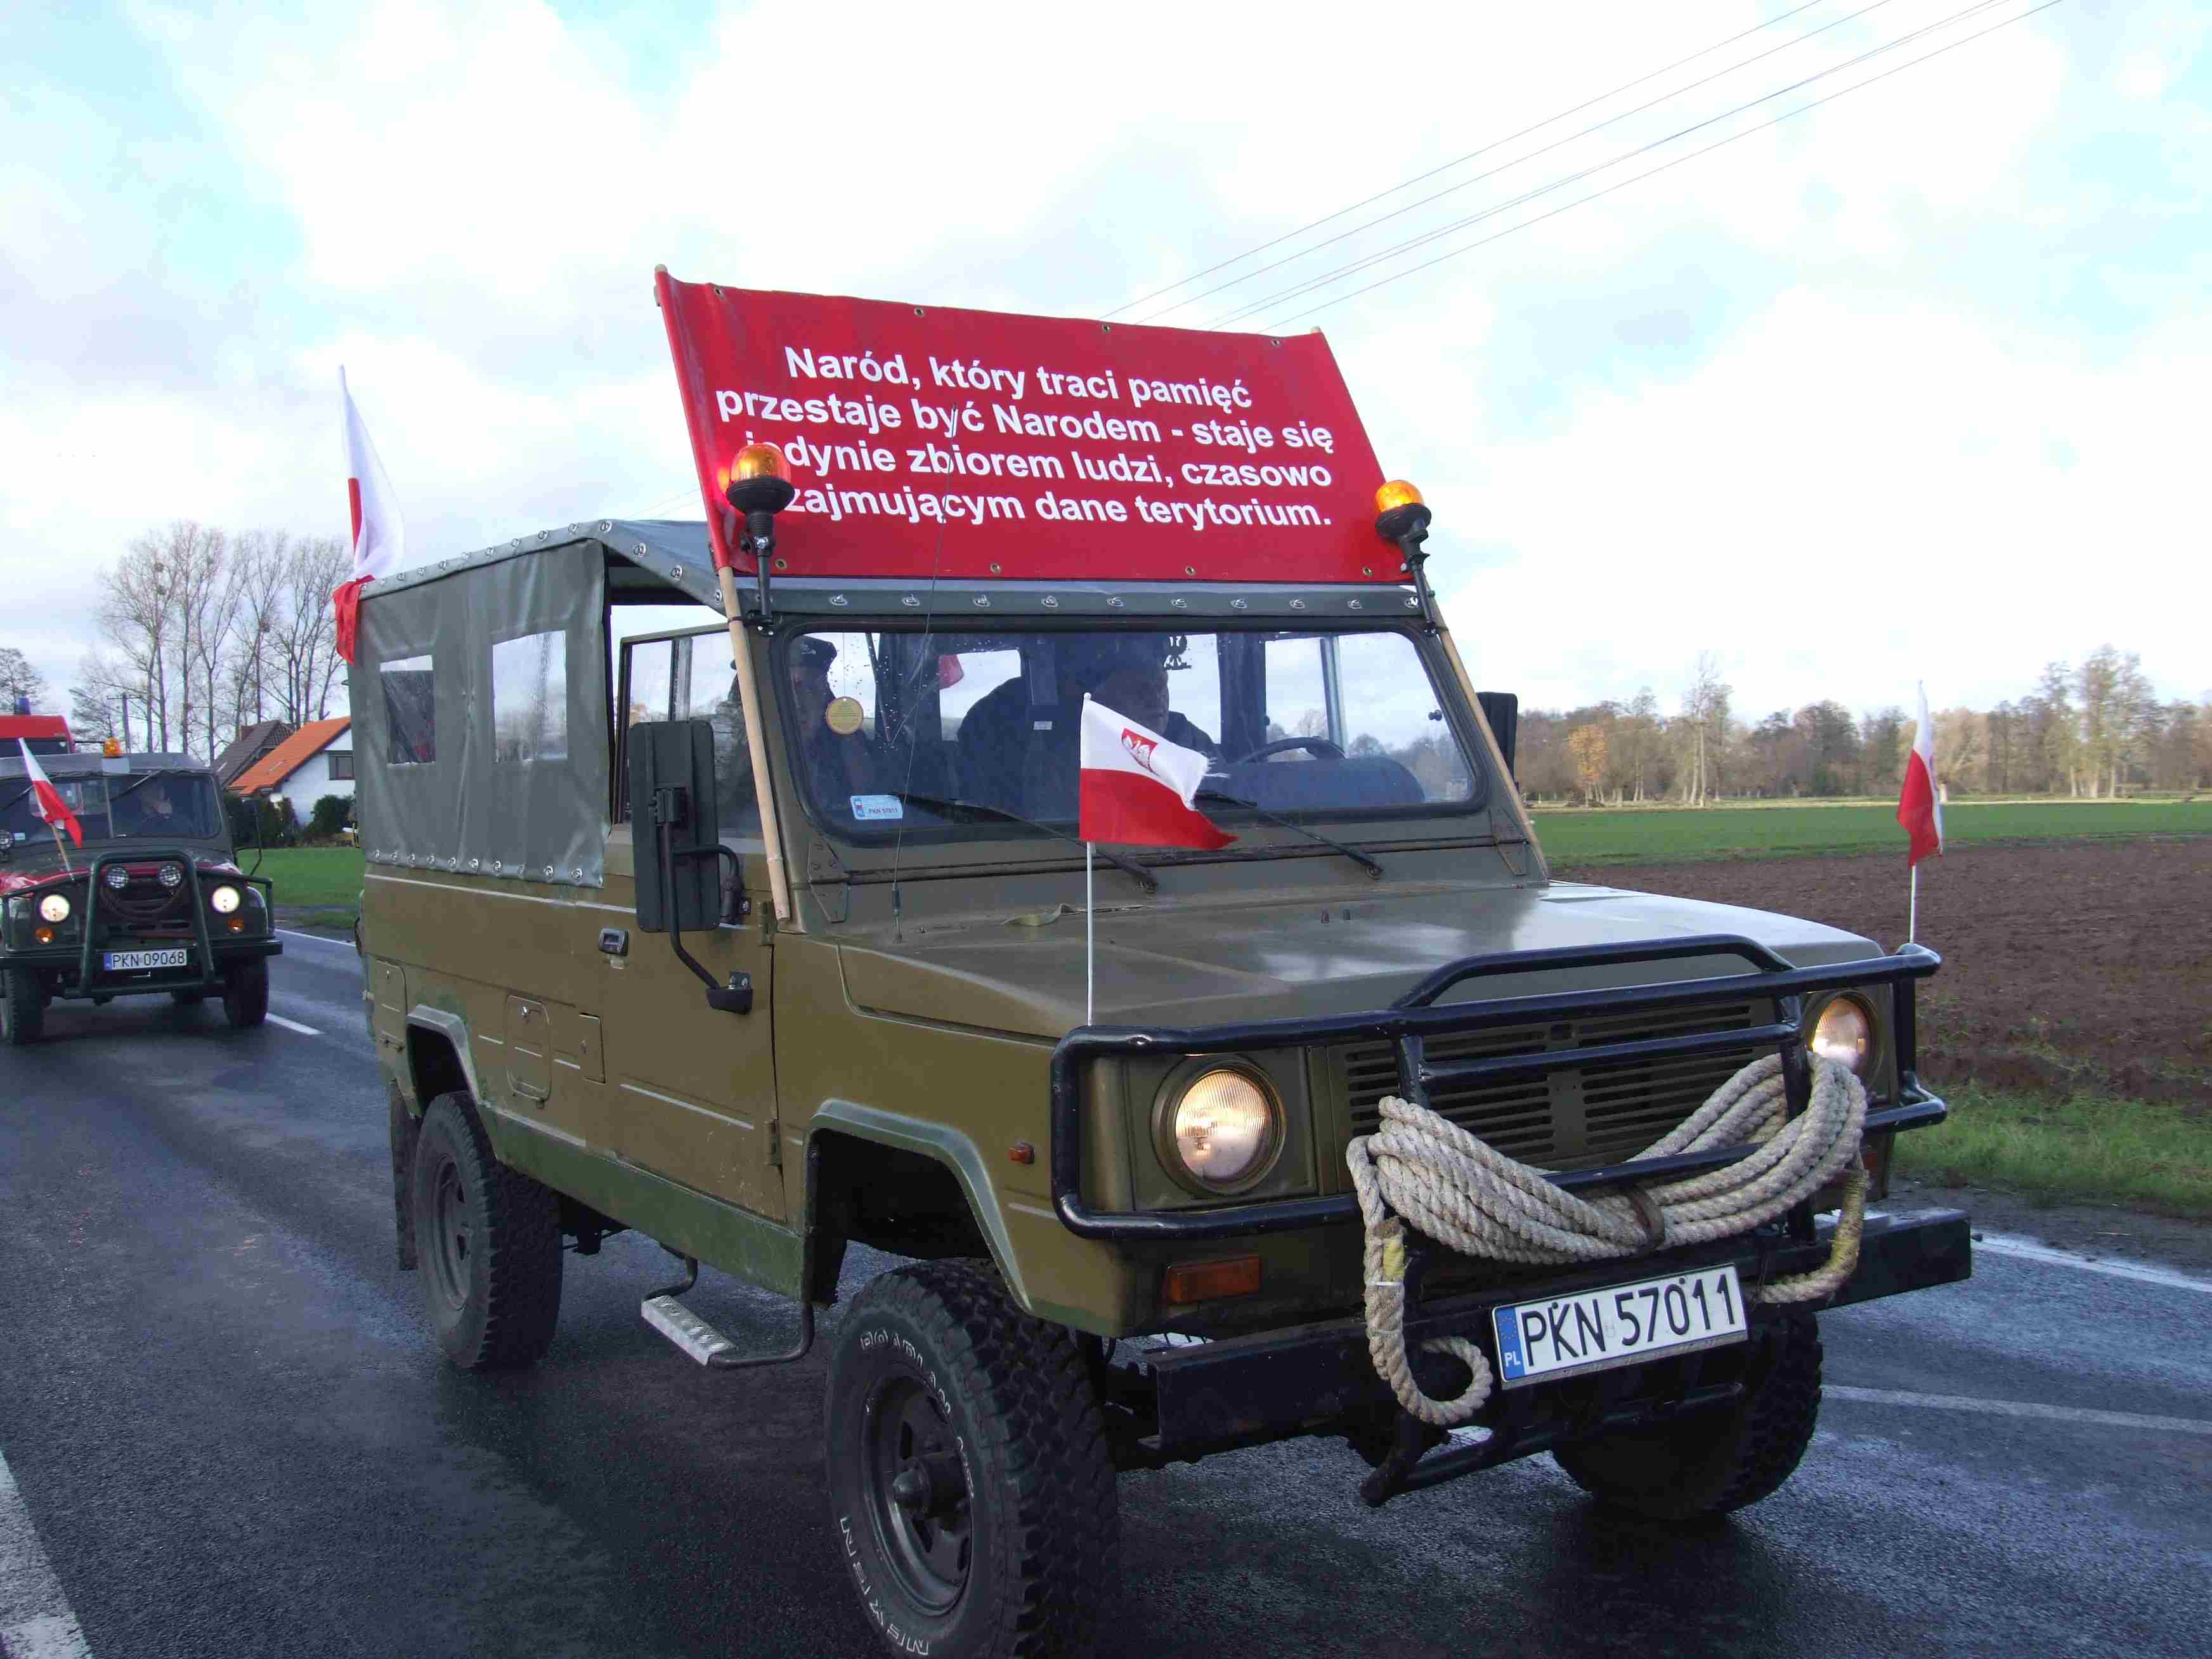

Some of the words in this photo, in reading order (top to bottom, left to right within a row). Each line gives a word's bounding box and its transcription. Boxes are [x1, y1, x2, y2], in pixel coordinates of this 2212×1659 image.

[784, 346, 921, 391] Naród,
[928, 356, 1025, 400] który
[1036, 366, 1119, 400] traci
[1128, 378, 1252, 414] pamięć
[715, 389, 902, 434] przestaje
[911, 398, 985, 439] być
[992, 403, 1161, 443] Narodem
[1171, 429, 1184, 437] -
[1191, 419, 1274, 454] staje
[1282, 420, 1334, 455] się
[746, 431, 896, 477] dynie
[906, 443, 1065, 479] zbiorem
[1070, 451, 1174, 488] ludzi,
[1181, 463, 1332, 487] czasowo
[784, 483, 1025, 525] zajmującym
[1035, 491, 1128, 522] dane
[1134, 495, 1332, 531] terytorium.
[112, 953, 140, 968] PKN
[143, 951, 185, 965] 09068
[1520, 1298, 1607, 1367] PKN
[1613, 1273, 1736, 1346] 57011
[1504, 1352, 1521, 1367] PL
